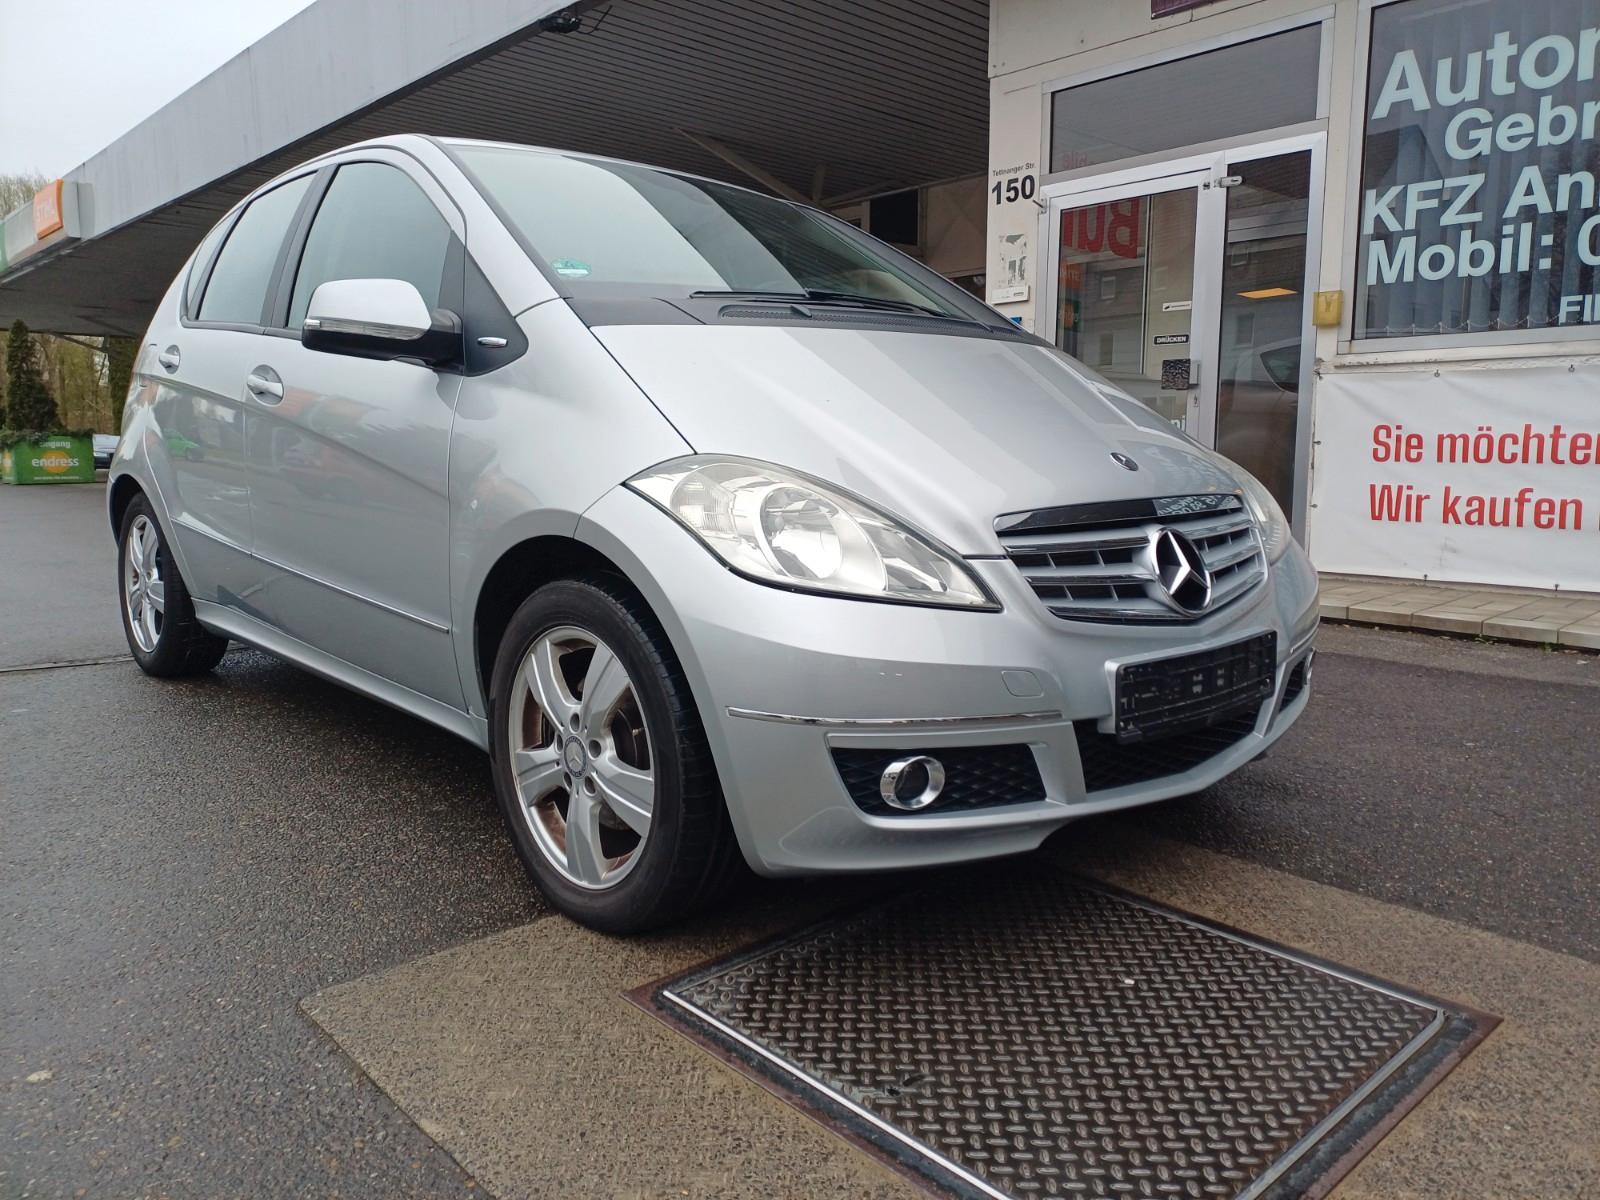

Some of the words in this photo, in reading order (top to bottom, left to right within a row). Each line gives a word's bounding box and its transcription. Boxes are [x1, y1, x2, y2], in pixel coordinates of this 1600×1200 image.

[991, 174, 1035, 205] 150
[1363, 173, 1486, 235] KFZ
[1502, 165, 1600, 219] An
[1366, 222, 1554, 286] Mobil:
[1156, 335, 1187, 344] DRÜCKEN
[32, 457, 79, 467] endress
[1372, 424, 1424, 463] Sie
[1369, 484, 1431, 523] Wir
[1442, 485, 1583, 531] kaufen
